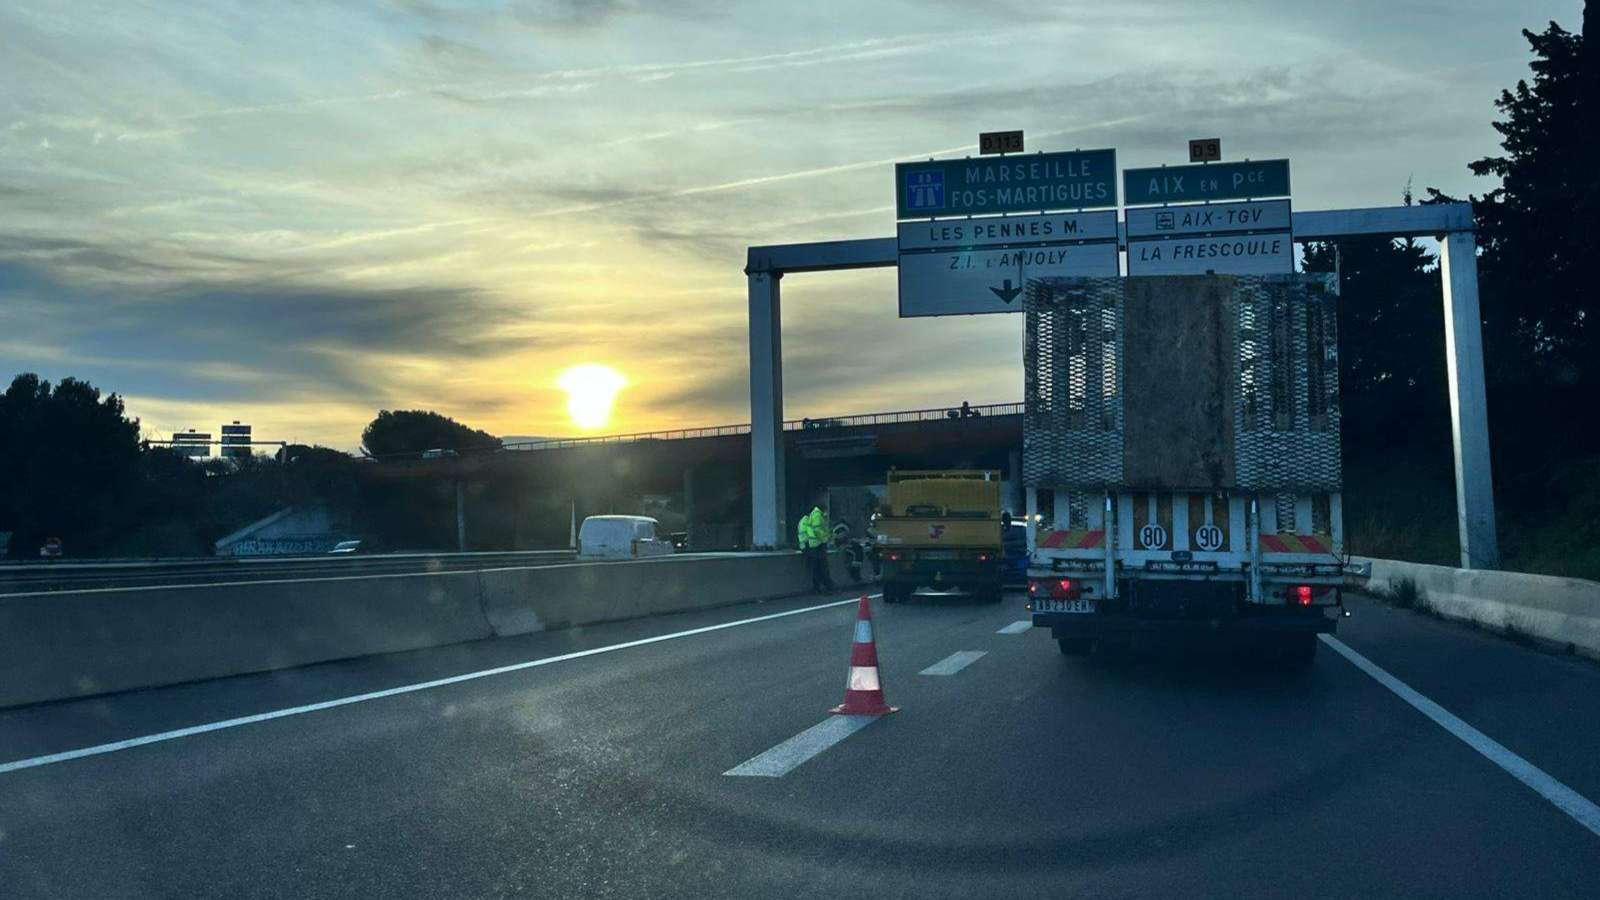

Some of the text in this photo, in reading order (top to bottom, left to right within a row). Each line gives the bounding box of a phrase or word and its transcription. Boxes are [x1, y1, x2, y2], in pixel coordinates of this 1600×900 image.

[1193, 143, 1217, 157] D 9
[965, 159, 1091, 184] MARSEILLE
[952, 182, 1107, 208] FOS-MARTIGUES
[1148, 176, 1185, 195] AIX
[1200, 180, 1219, 192] EN
[1182, 209, 1263, 228] AIX-TGV
[930, 219, 1084, 242] LES PENNES M.
[1141, 240, 1281, 262] LA FRESCOULE
[950, 255, 975, 271] Z.I.
[1143, 528, 1162, 548] 80
[1199, 527, 1219, 547] 90
